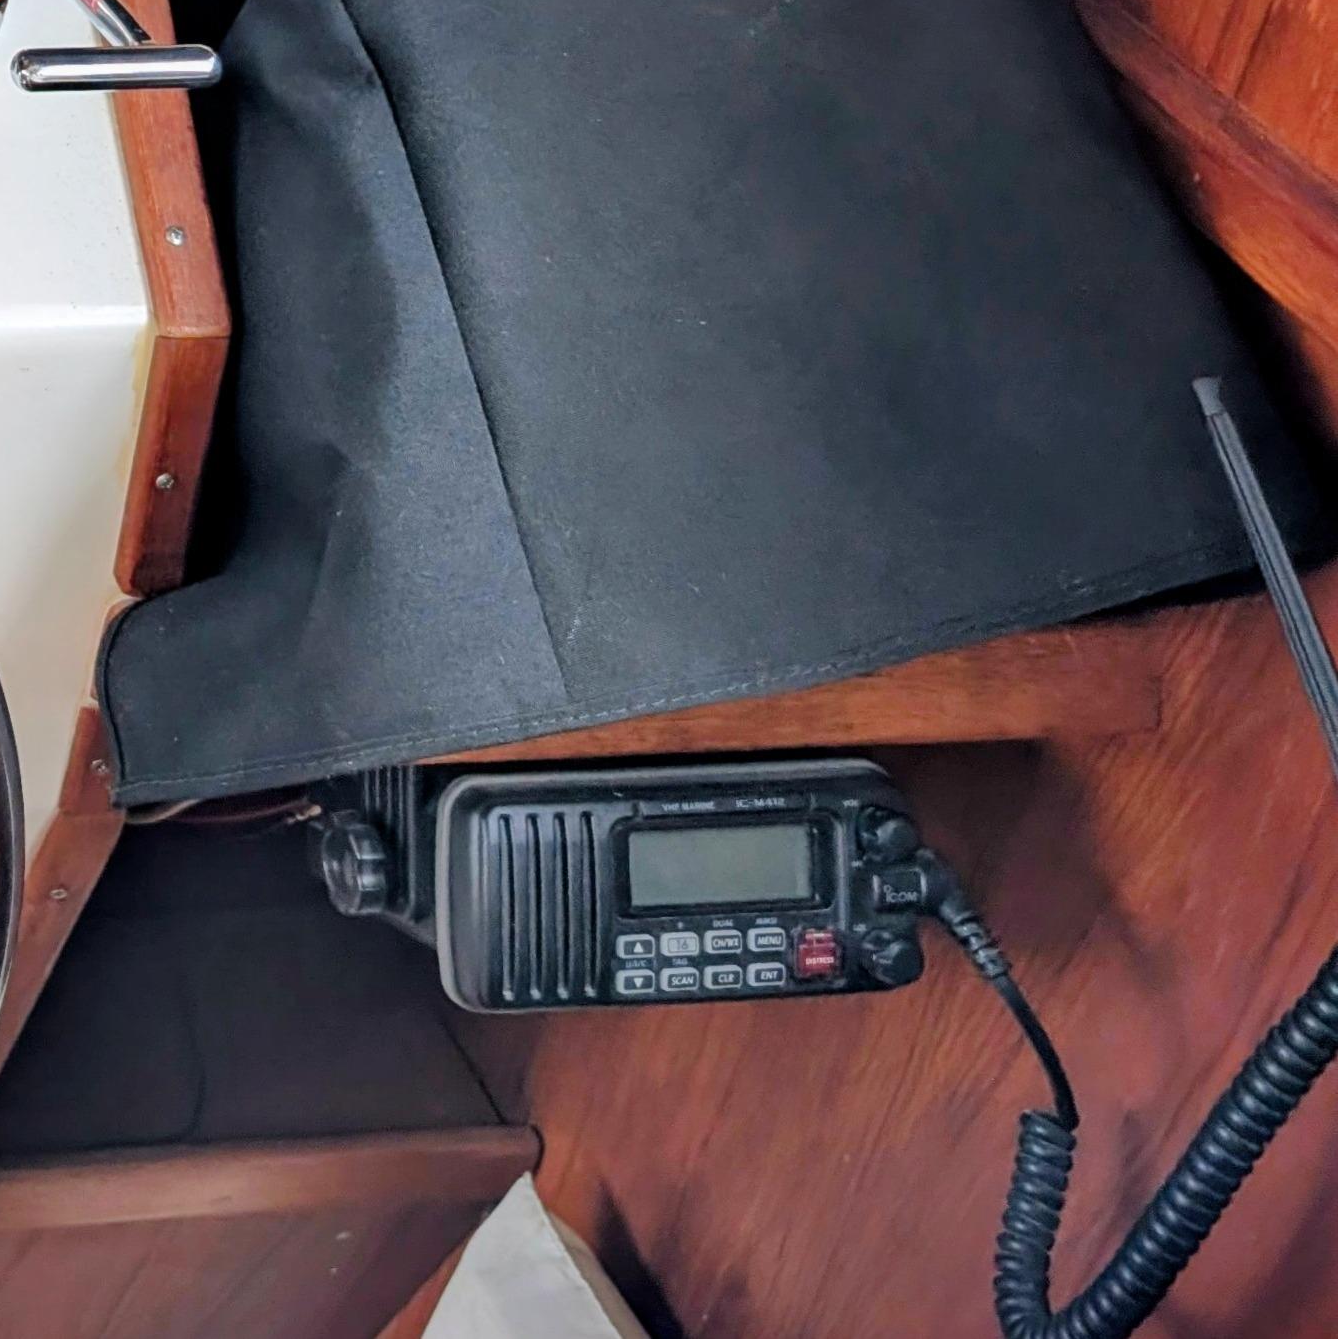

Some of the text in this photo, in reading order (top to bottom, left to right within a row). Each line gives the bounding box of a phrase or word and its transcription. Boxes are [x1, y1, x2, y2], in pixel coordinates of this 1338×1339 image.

[757, 934, 782, 946] MENU
[671, 975, 694, 986] SCAN
[760, 970, 778, 981] ENT
